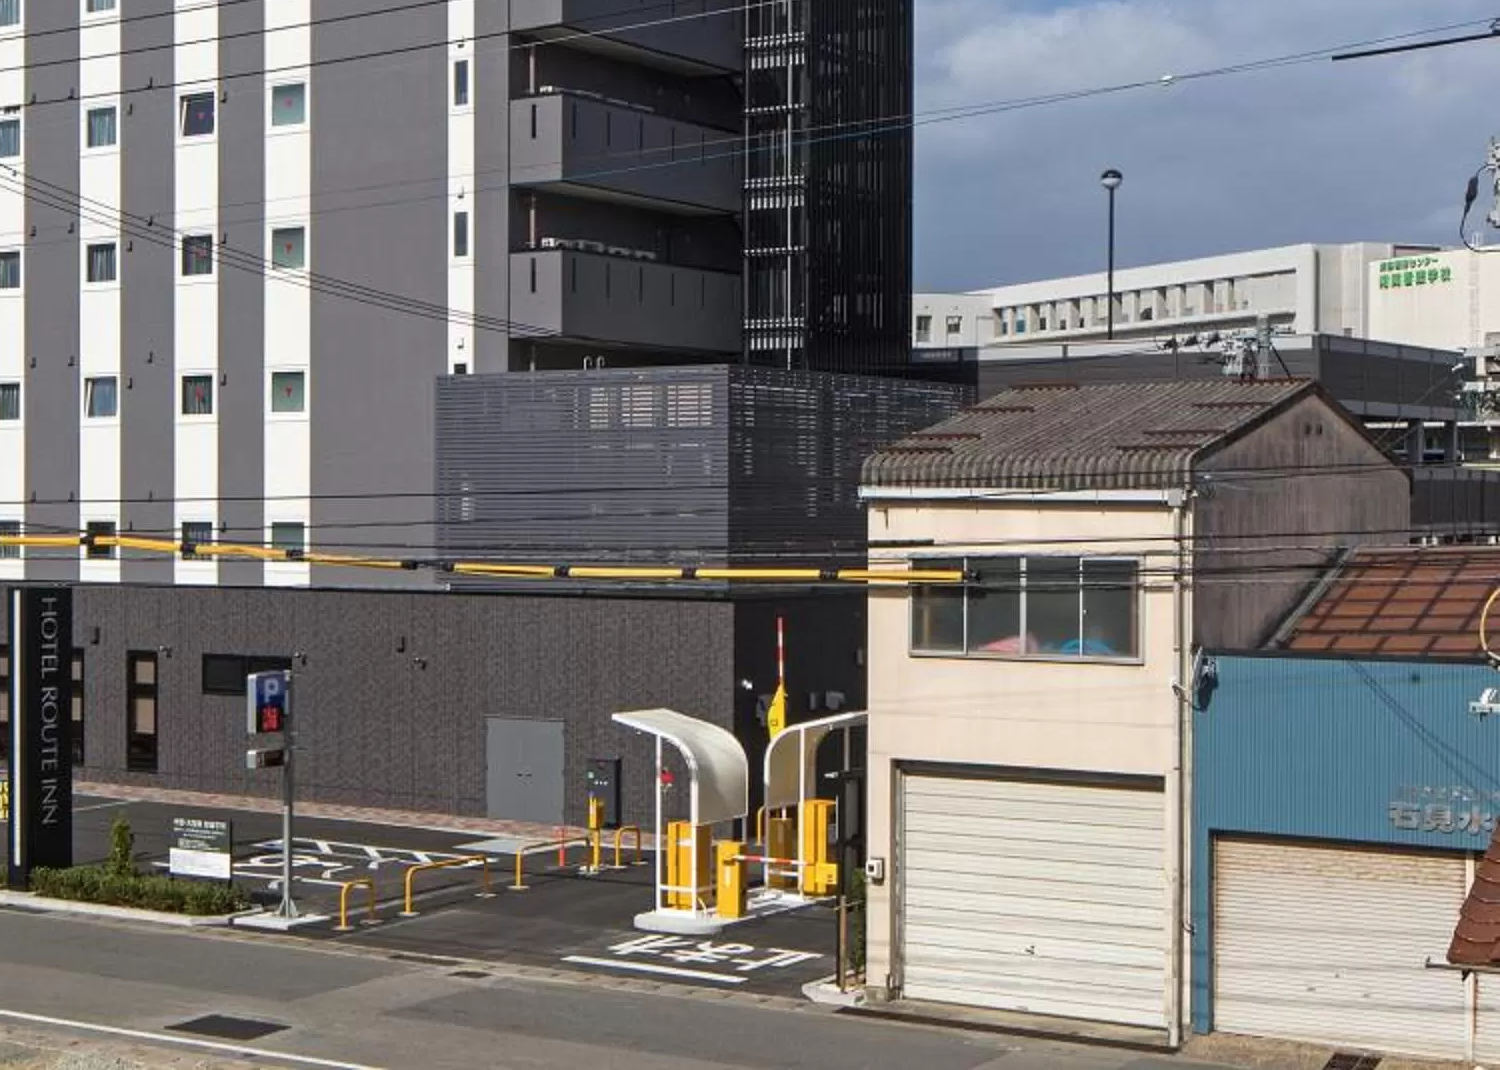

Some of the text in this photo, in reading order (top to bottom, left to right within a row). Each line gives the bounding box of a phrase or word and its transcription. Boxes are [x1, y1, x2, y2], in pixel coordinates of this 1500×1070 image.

[41, 597, 59, 826] HOTEL ROUTE INN
[264, 678, 279, 703] P
